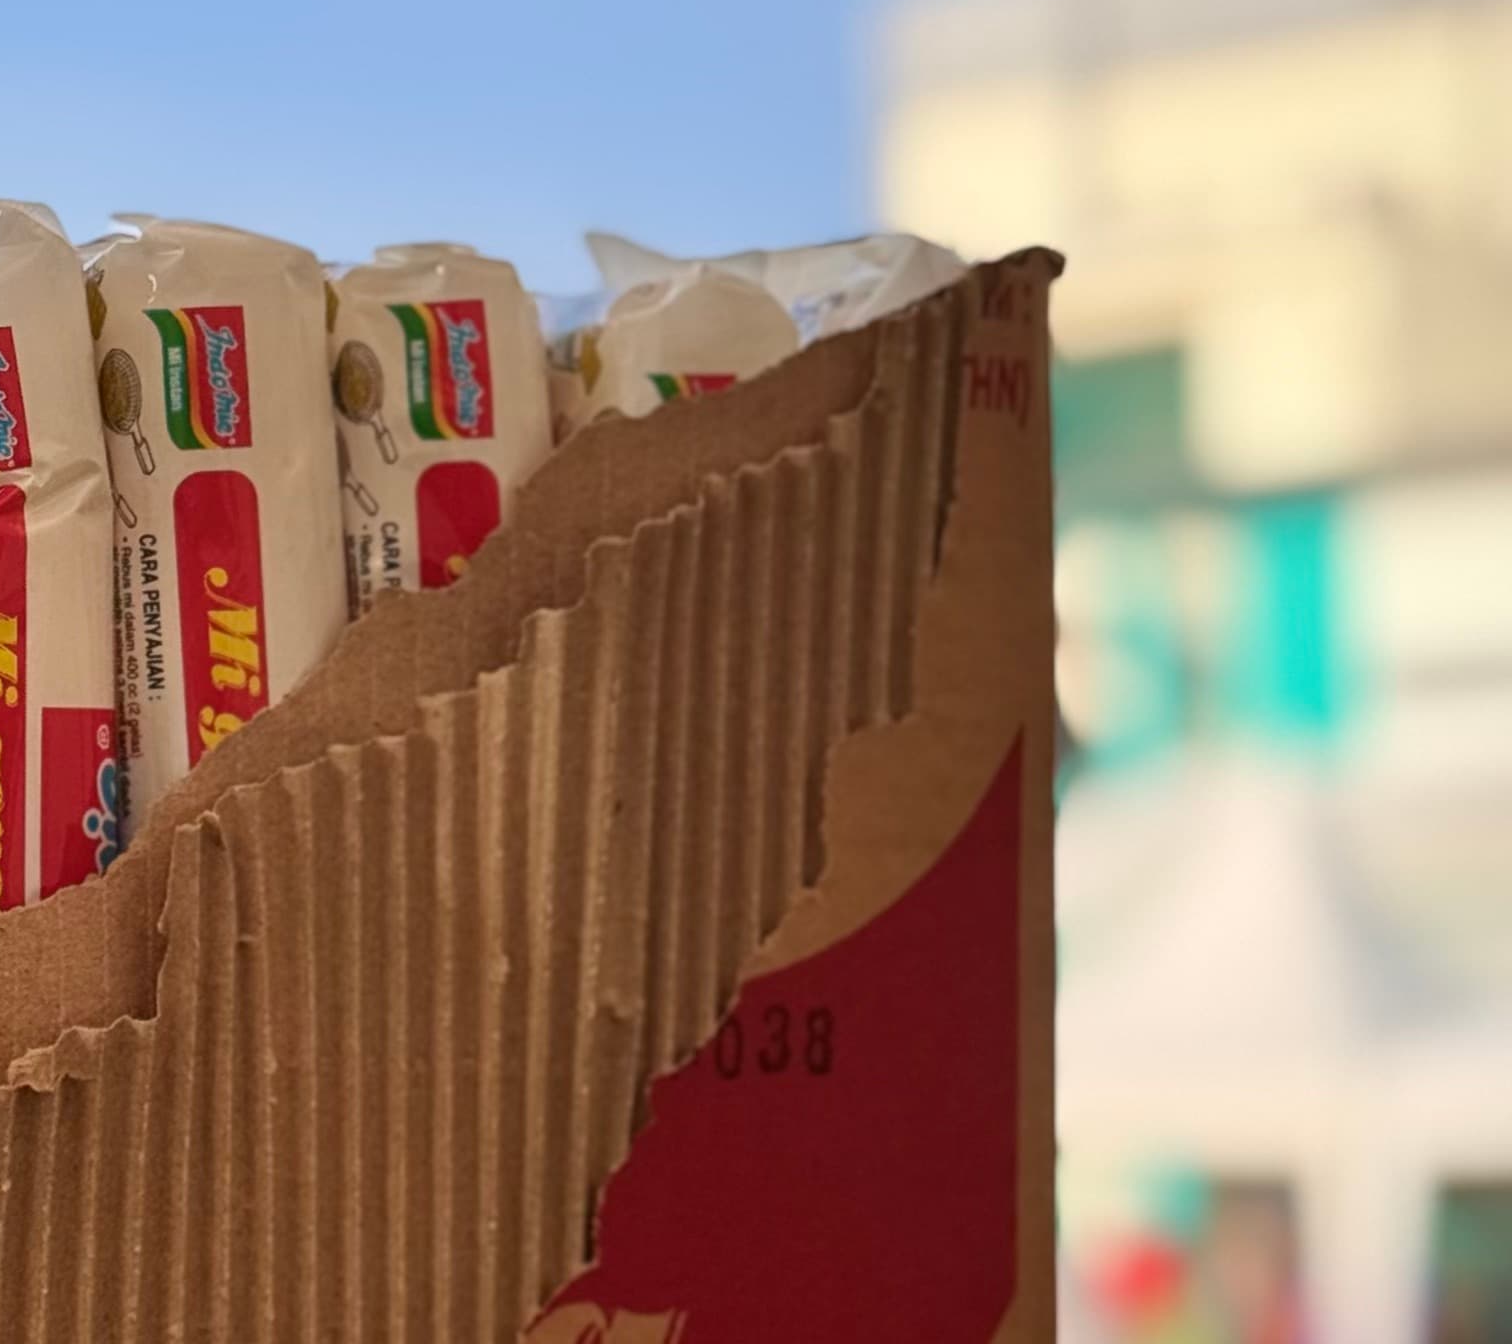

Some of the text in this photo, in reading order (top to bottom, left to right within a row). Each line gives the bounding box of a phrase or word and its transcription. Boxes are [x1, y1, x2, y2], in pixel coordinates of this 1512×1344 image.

[168, 347, 182, 411] Mi Instan
[139, 534, 158, 584] CARA
[143, 590, 165, 689] PENYAJIAN
[202, 567, 261, 698] Mi
[127, 656, 138, 679] 400
